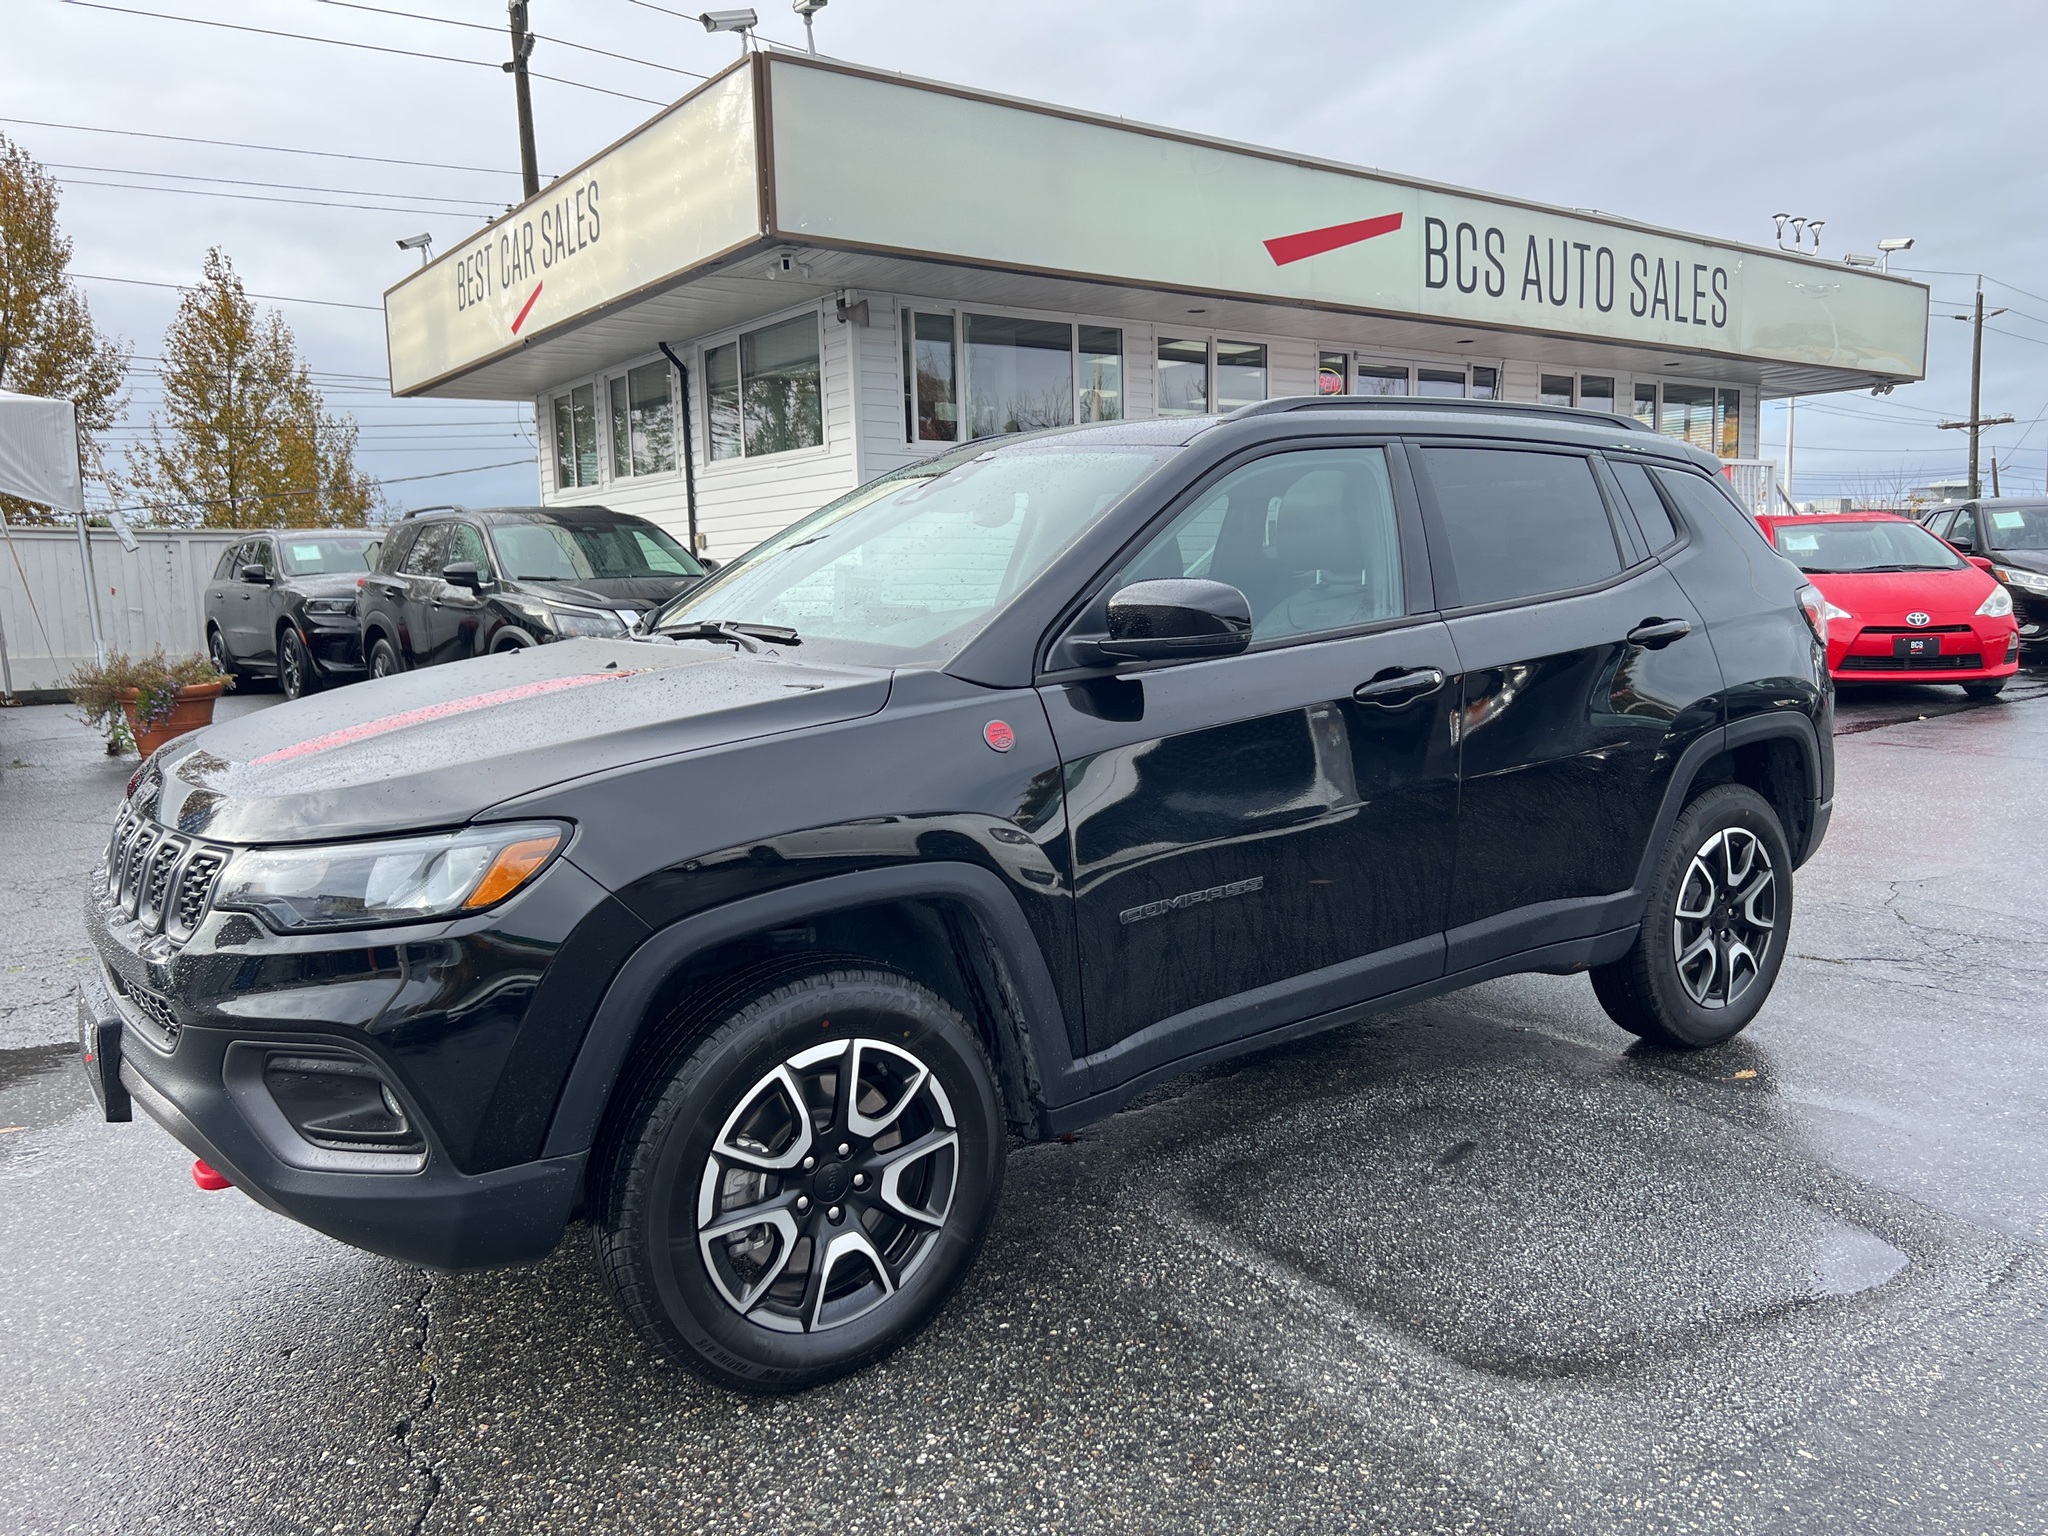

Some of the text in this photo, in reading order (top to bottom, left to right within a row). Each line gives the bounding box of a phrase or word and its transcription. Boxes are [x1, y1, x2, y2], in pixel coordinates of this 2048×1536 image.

[457, 181, 600, 311] BEST CAR SALES
[1425, 217, 1728, 328] BCS AUTO SALES
[1318, 375, 1340, 392] PEN
[1910, 641, 1924, 649] BCS
[1119, 876, 1264, 924] COMPASS
[713, 1352, 753, 1374] TOURING
